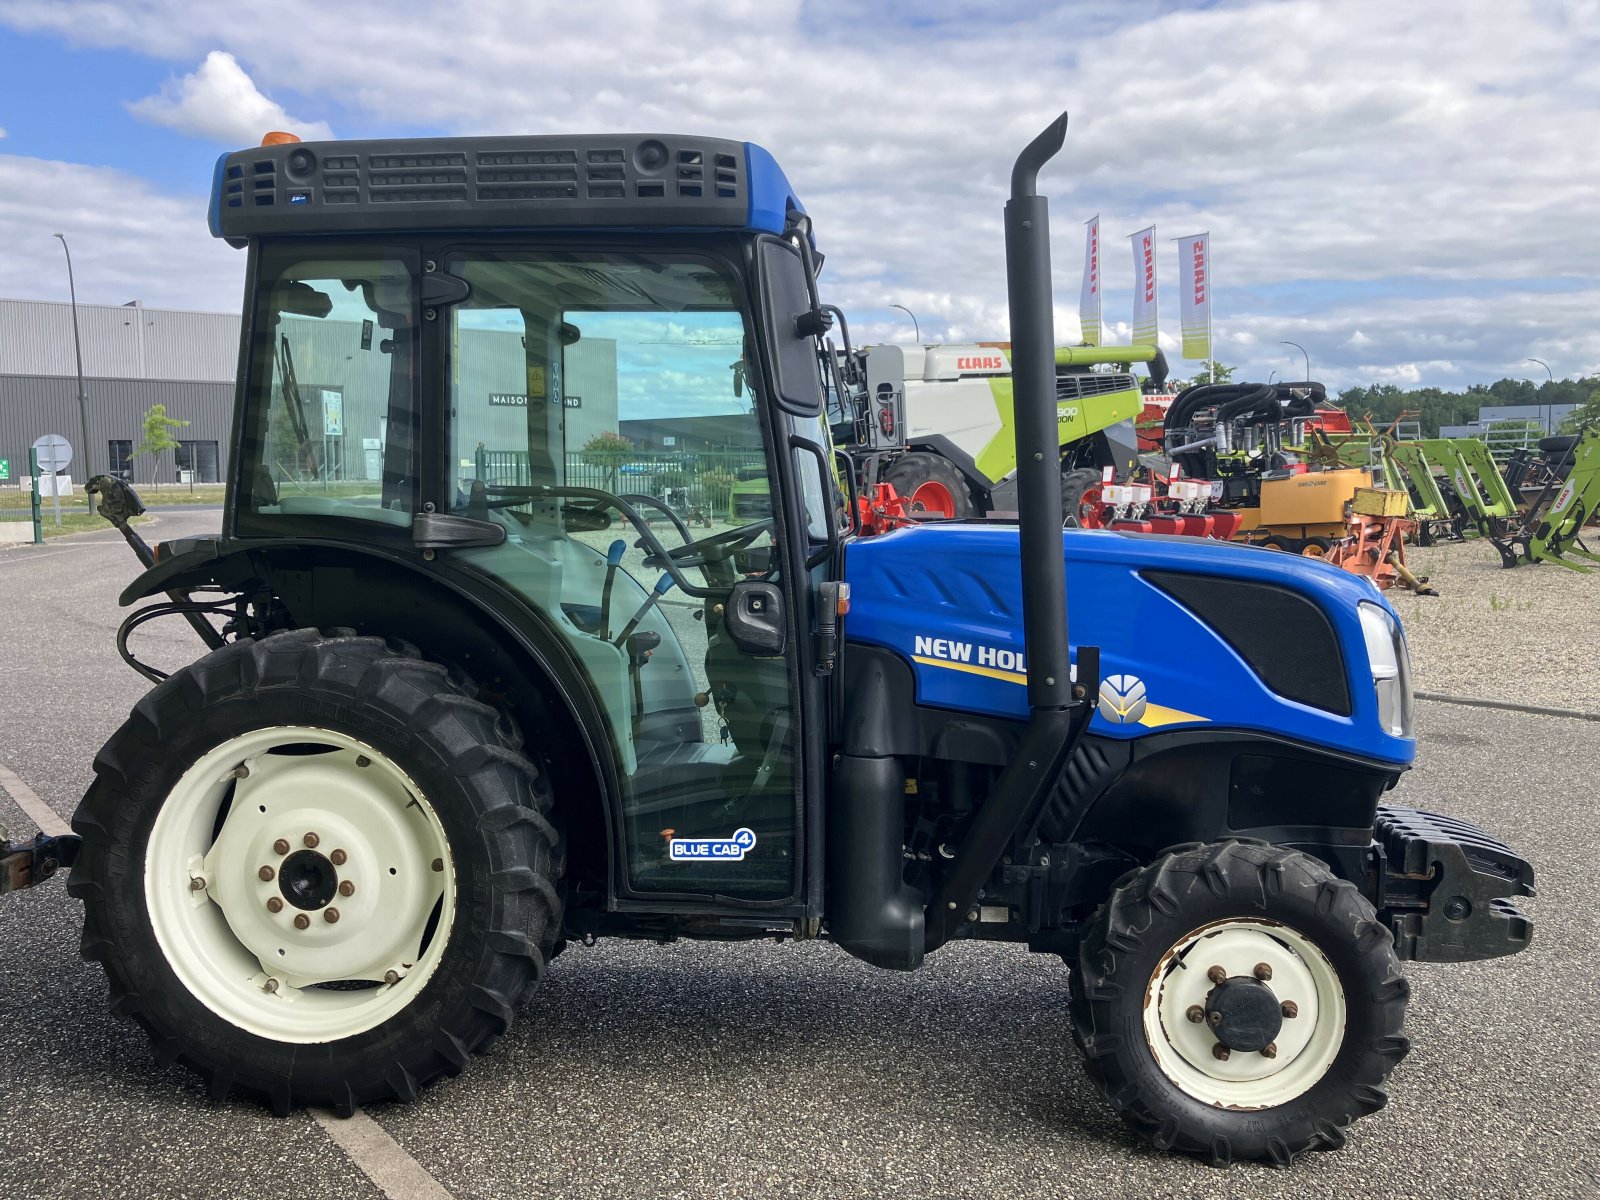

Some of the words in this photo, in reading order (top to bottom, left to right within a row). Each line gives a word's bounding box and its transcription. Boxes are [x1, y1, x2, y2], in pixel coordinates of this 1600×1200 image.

[957, 356, 1002, 369] CLAAS
[1555, 489, 1570, 510] CLAAS
[915, 635, 973, 662] NEW
[674, 844, 709, 856] BLUE
[712, 844, 741, 856] CAB
[737, 832, 752, 845] 4
